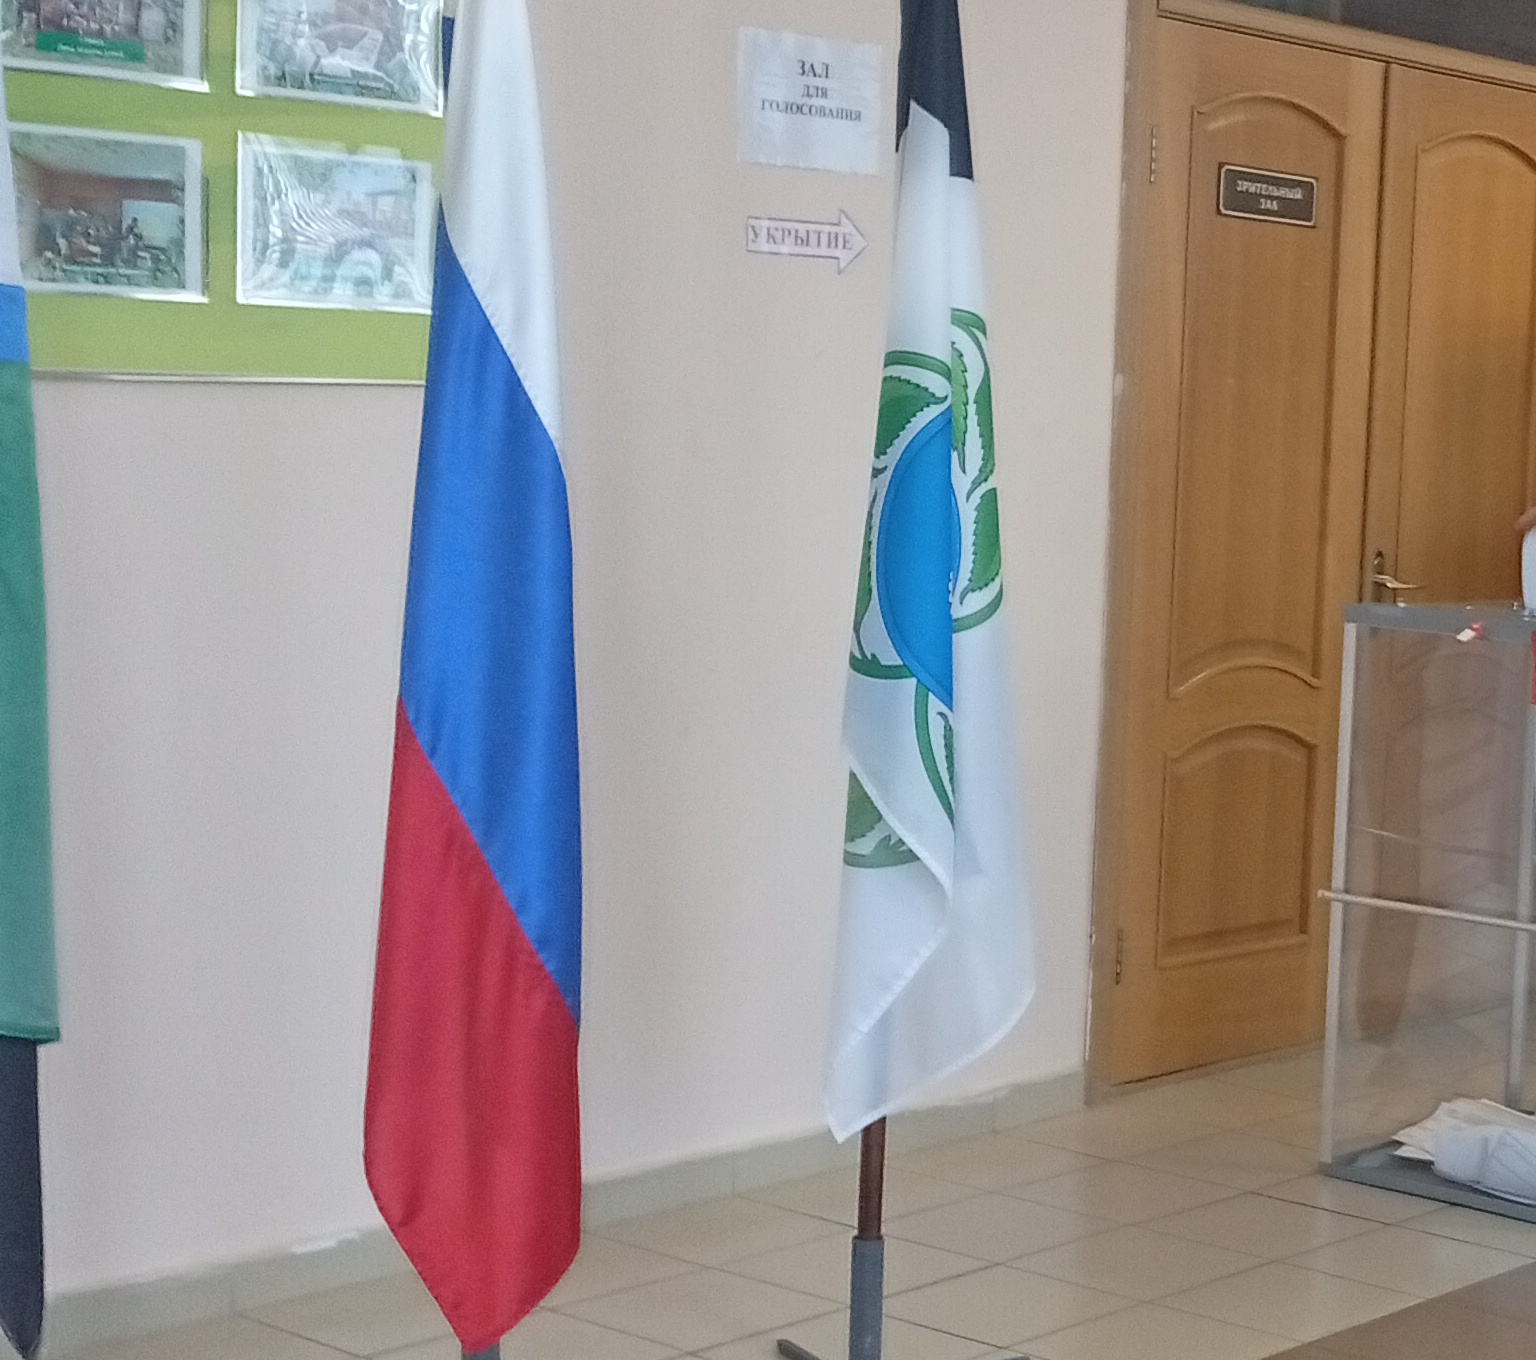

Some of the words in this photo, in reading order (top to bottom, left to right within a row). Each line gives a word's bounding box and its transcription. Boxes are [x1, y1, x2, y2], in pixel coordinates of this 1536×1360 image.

[797, 59, 830, 78] ЗАЛ
[801, 84, 829, 100] ДЛЯ
[761, 99, 862, 122] ГОЛОСОВАНИЯ
[750, 225, 854, 250] УКРЫТИЕ
